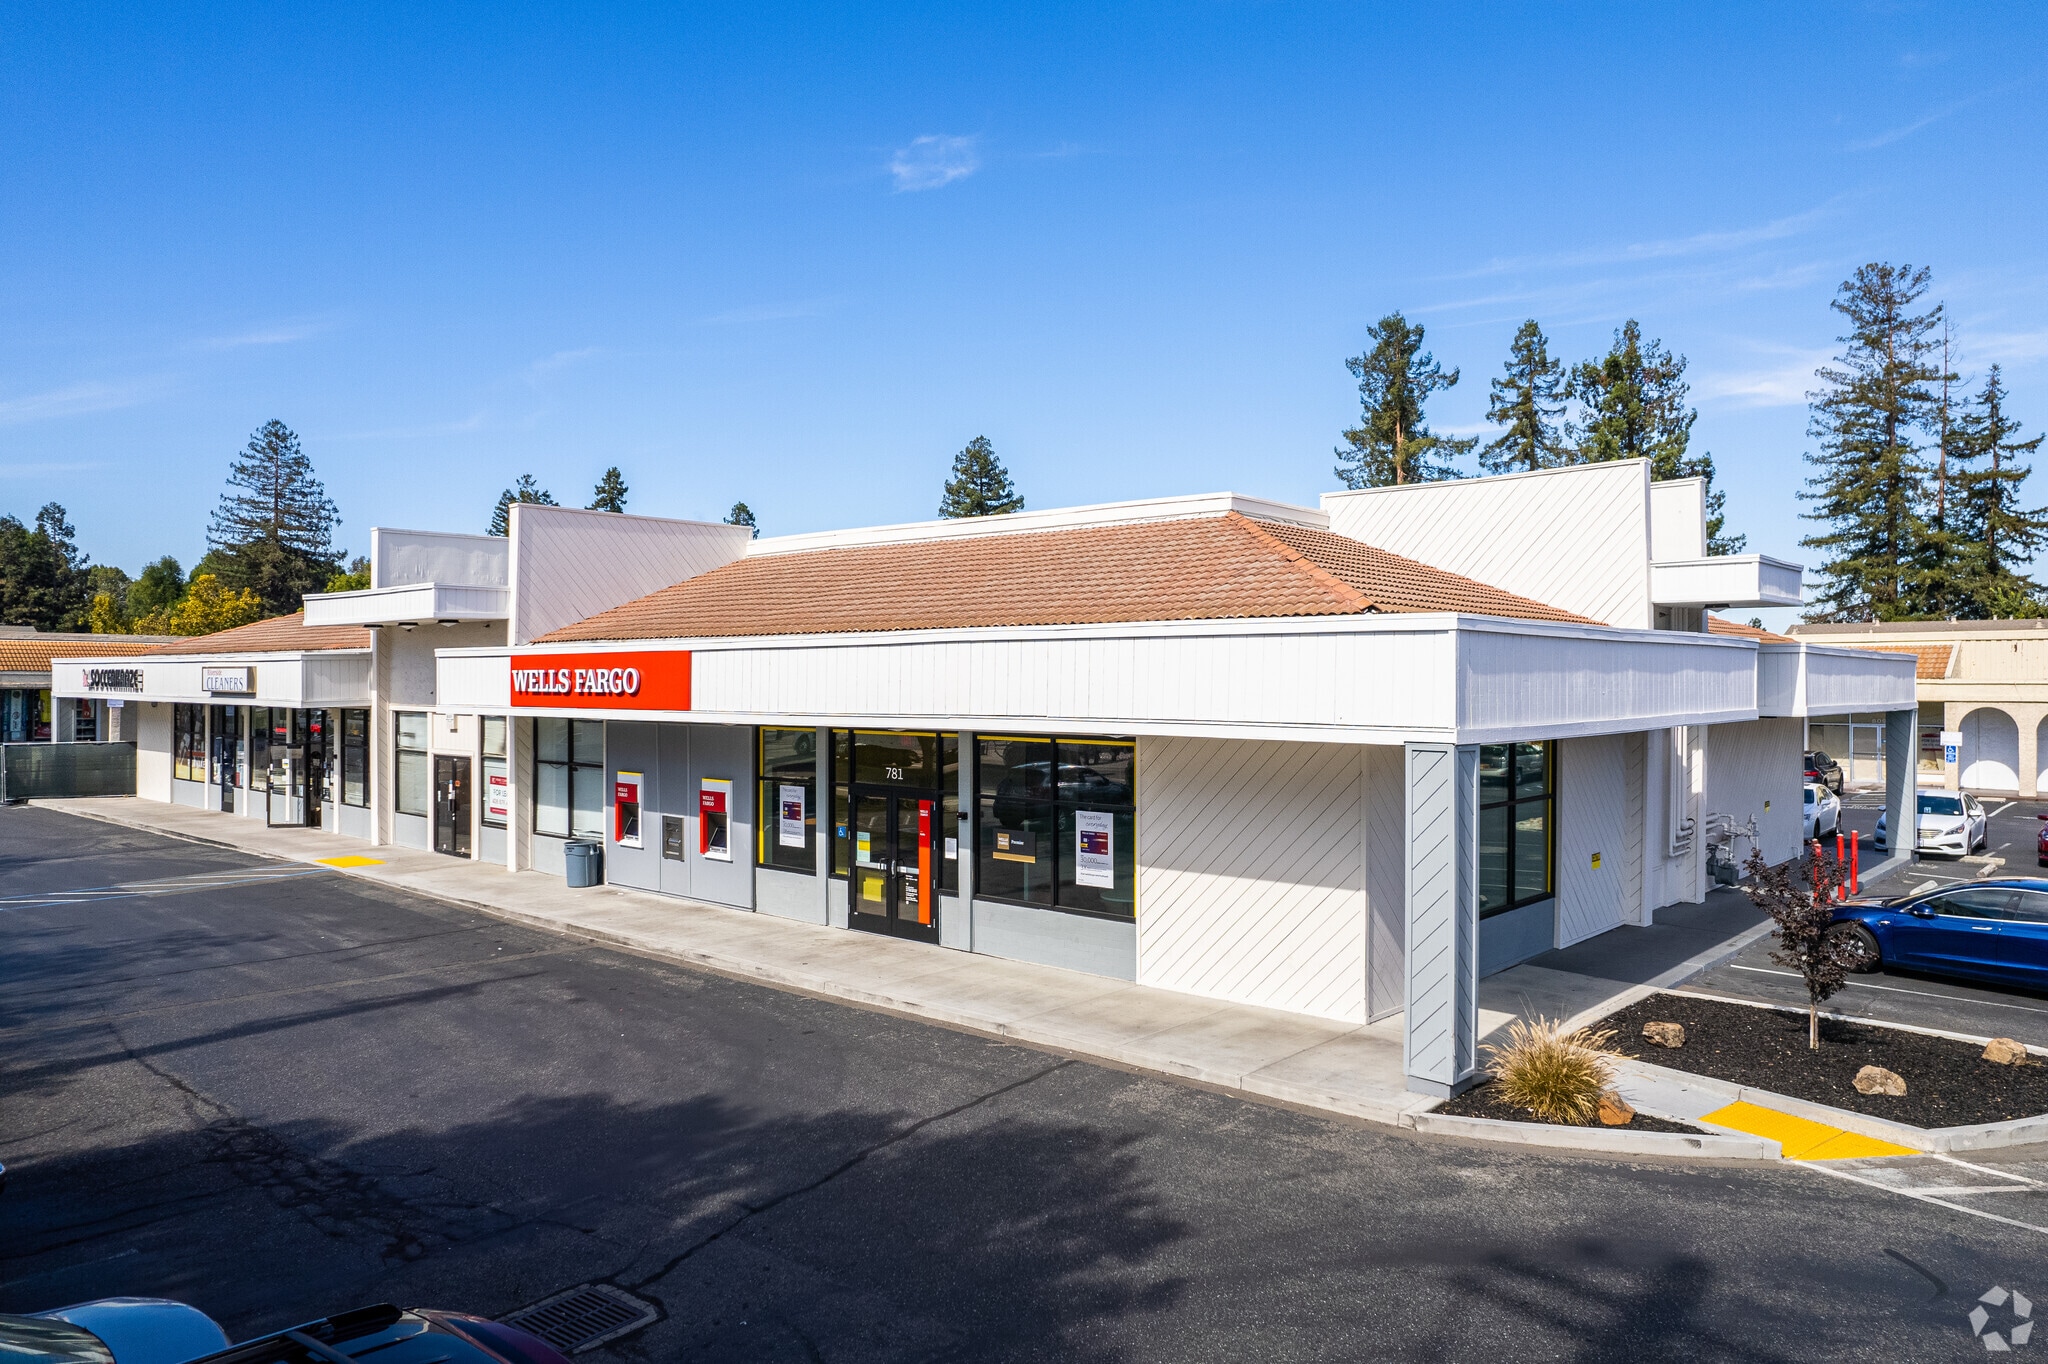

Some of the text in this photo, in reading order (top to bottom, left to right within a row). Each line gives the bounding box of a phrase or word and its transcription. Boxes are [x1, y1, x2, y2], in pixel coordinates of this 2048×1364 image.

[206, 677, 244, 691] CLEANERS
[512, 668, 641, 694] WELLS FARGO
[885, 767, 904, 780] 781
